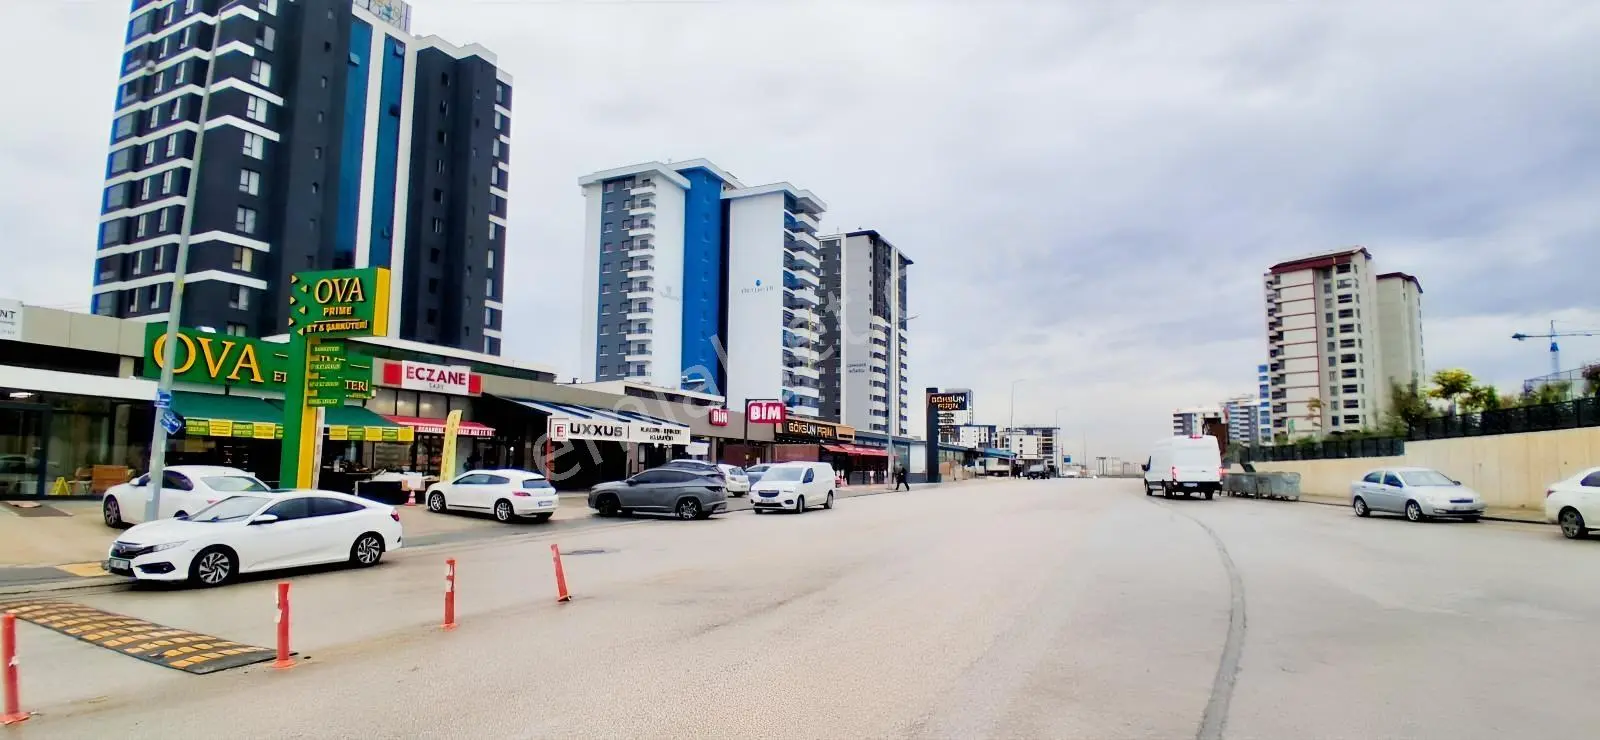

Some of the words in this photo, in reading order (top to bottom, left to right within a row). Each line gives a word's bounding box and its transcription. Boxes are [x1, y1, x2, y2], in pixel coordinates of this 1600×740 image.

[314, 277, 364, 304] OVA
[323, 306, 352, 316] PRIME
[153, 332, 264, 383] OVA
[406, 366, 467, 386] ECZANE
[750, 402, 781, 420] BİM
